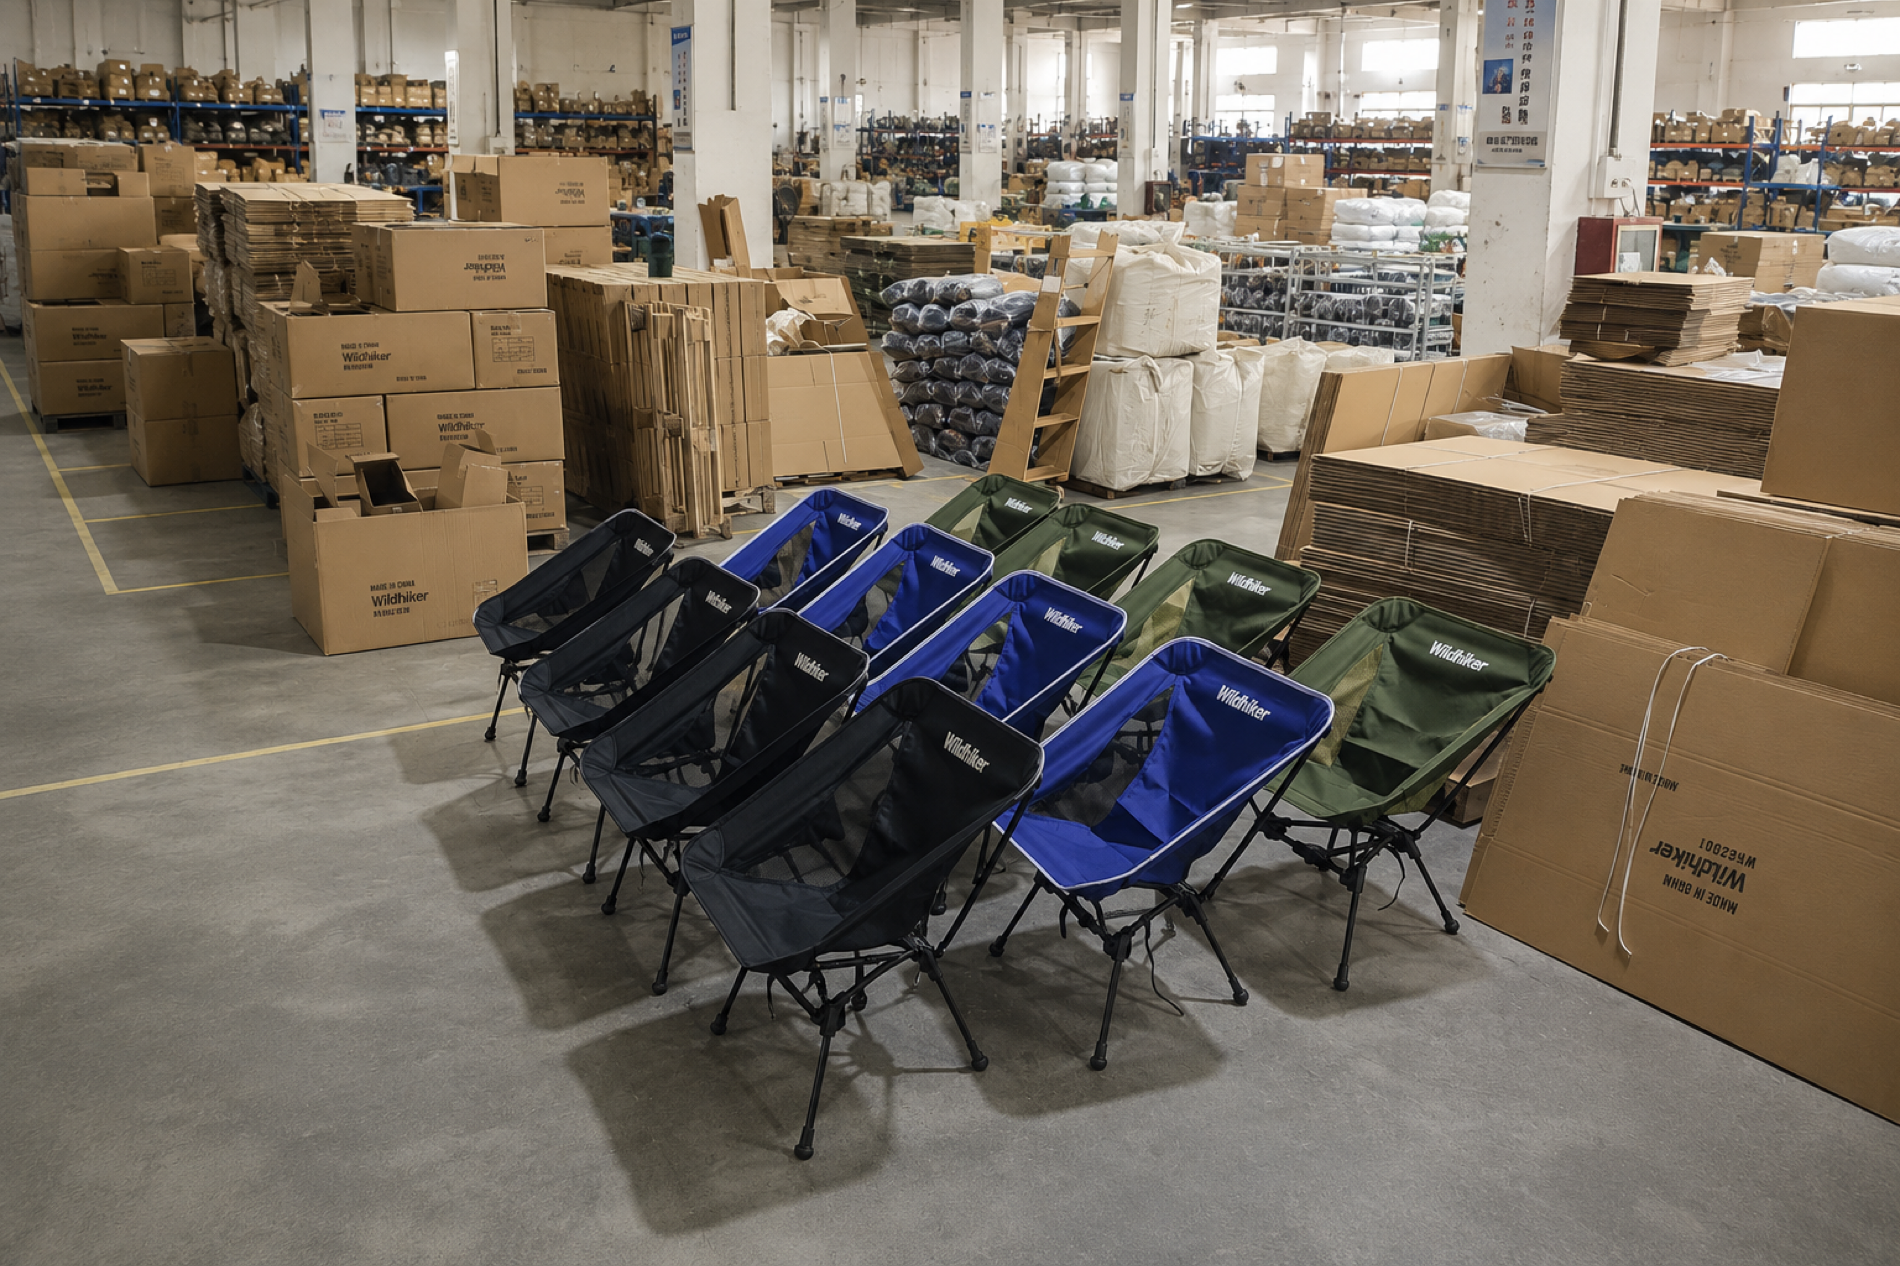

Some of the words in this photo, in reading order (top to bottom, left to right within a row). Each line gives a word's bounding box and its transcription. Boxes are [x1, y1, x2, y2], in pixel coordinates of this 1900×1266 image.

[371, 591, 429, 607] Wildhiker
[1429, 640, 1489, 671] Wildhiker
[1216, 684, 1272, 722] Wildhiker
[943, 730, 990, 774] Wildhiker
[1649, 841, 1746, 893] Wildhiker
